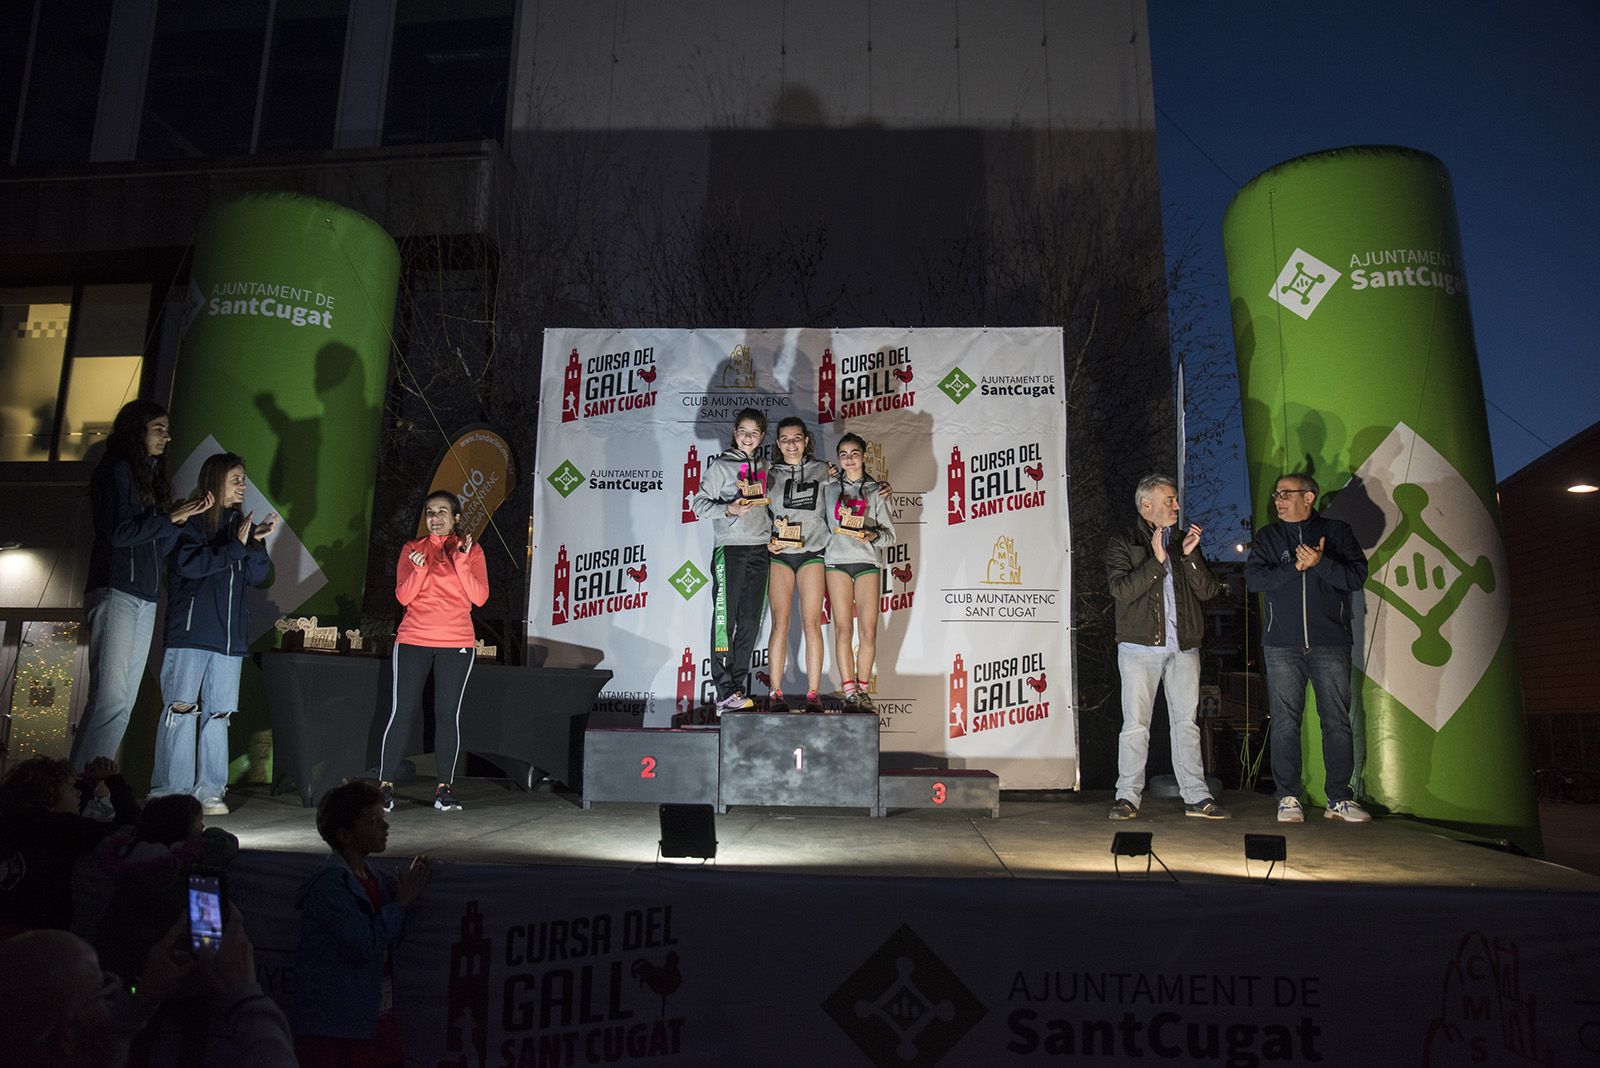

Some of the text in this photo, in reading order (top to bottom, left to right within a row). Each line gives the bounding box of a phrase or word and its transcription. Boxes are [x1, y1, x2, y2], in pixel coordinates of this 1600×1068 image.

[211, 282, 335, 310] AJUNTAMENT DE
[207, 297, 334, 330] SantCugat
[587, 347, 656, 375] CURSA DEL
[841, 346, 911, 375] CURSA DEL
[585, 369, 638, 401] GALL
[841, 370, 895, 402] GALL
[981, 375, 1055, 384] AJUNTAMENT DE
[981, 384, 1056, 397] SantCugat
[584, 391, 658, 418] SANT CUGAT
[682, 396, 789, 407] CLUB MUNTANYENC
[700, 408, 729, 419] SANT
[840, 391, 916, 419] SANT CUGAT
[971, 443, 1042, 473] CURSA DEL
[589, 478, 663, 492] SantCugat
[590, 469, 663, 479] AJUNTAMENT DE
[971, 467, 1026, 501] GALL
[971, 490, 1046, 519] SANT CUGAT
[575, 545, 647, 573] CURSA DEL
[887, 543, 911, 564] DEL
[574, 568, 627, 601] GALL
[573, 591, 648, 620] SANT CUGAT
[880, 591, 914, 613] UGAT
[944, 593, 1055, 605] CLUB MUNTANYENC
[965, 607, 1037, 617] SANT CUGAT
[974, 652, 1046, 683] CURSA DEL
[591, 700, 656, 716] antCugat
[599, 691, 656, 701] NTAMENT DE
[973, 679, 1029, 714] GALL
[972, 702, 1050, 733] SANT CUGAT
[641, 756, 656, 778] 2
[793, 747, 804, 770] 1
[931, 781, 947, 805] 3
[505, 905, 679, 966] CURSA DEL
[502, 960, 633, 1032] GALL
[1008, 971, 1321, 1008] AJUNTAMENT DE
[500, 1017, 686, 1068] SANT CUGAT
[1006, 1008, 1323, 1068] SantCugat
